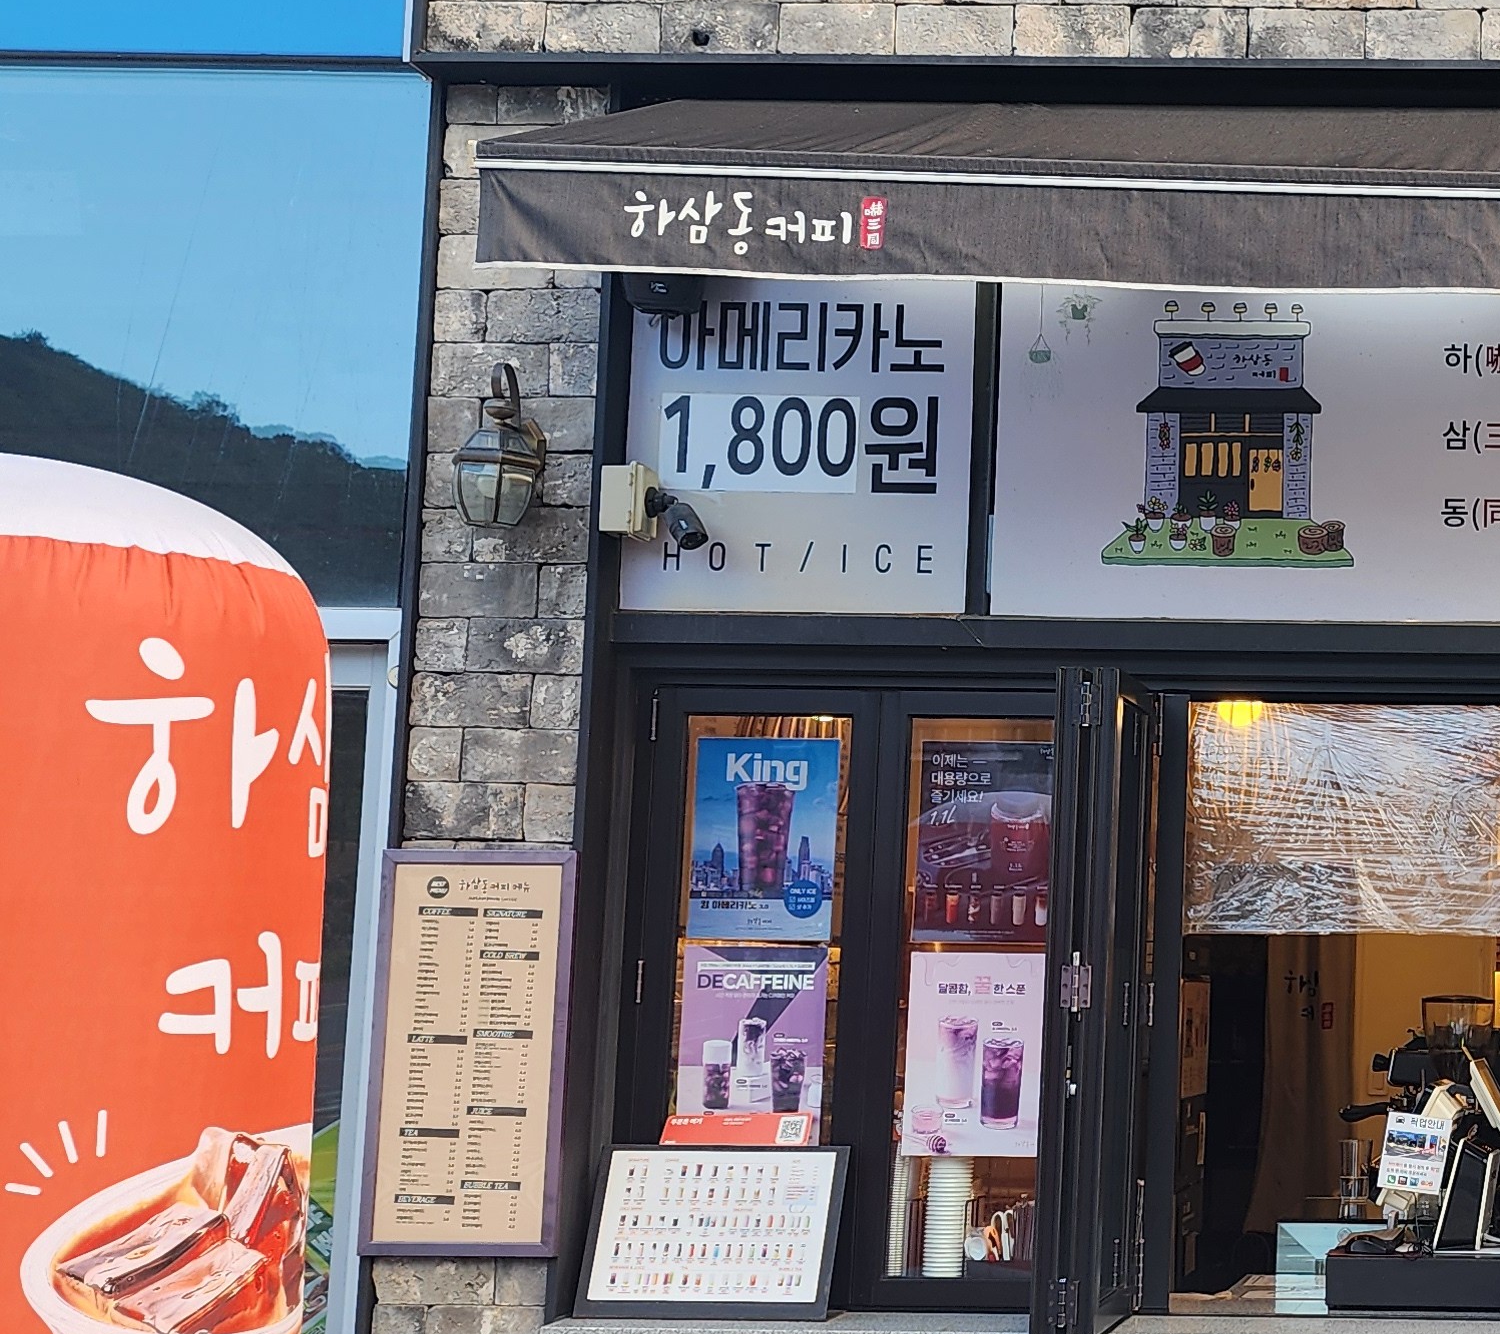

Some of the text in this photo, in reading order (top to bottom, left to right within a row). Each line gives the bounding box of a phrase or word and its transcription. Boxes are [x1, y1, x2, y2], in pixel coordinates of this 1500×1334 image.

[659, 302, 945, 373] 아메리카노
[663, 394, 939, 495] 1,800원
[932, 753, 968, 768] 이제는
[726, 752, 809, 791] King
[931, 771, 992, 785] 대용량으로
[930, 789, 983, 804] 즐기세요!
[697, 974, 816, 990] DECAFFEINE
[993, 984, 1004, 995] 한
[1005, 984, 1026, 995] 스푼
